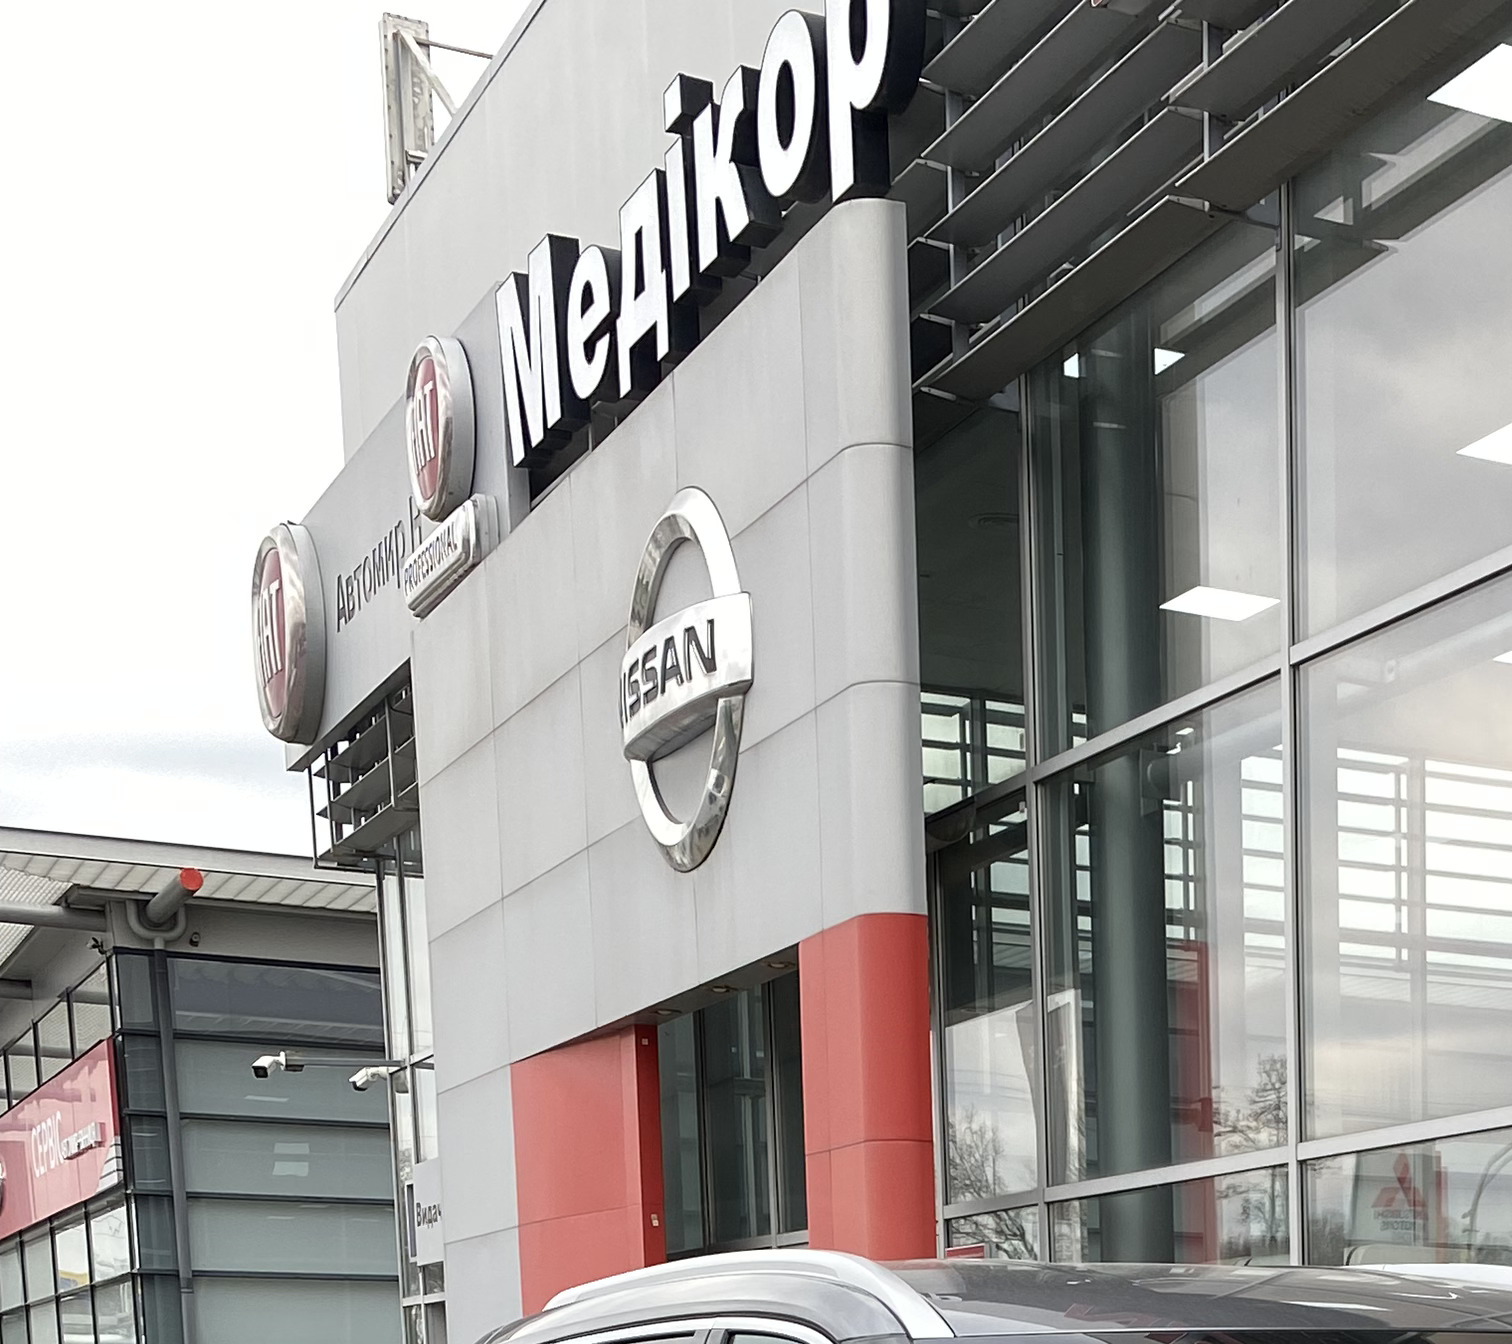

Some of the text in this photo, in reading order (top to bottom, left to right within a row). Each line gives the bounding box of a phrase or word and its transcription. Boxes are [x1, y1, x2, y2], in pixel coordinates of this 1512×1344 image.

[495, 0, 891, 467] Медікор
[411, 381, 436, 474] IAT
[336, 519, 406, 633] Автомир
[404, 521, 458, 596] PROFESSIONAL
[257, 579, 283, 688] IAT
[620, 618, 718, 726] ISSAN
[31, 1110, 65, 1178] СЕРВІС
